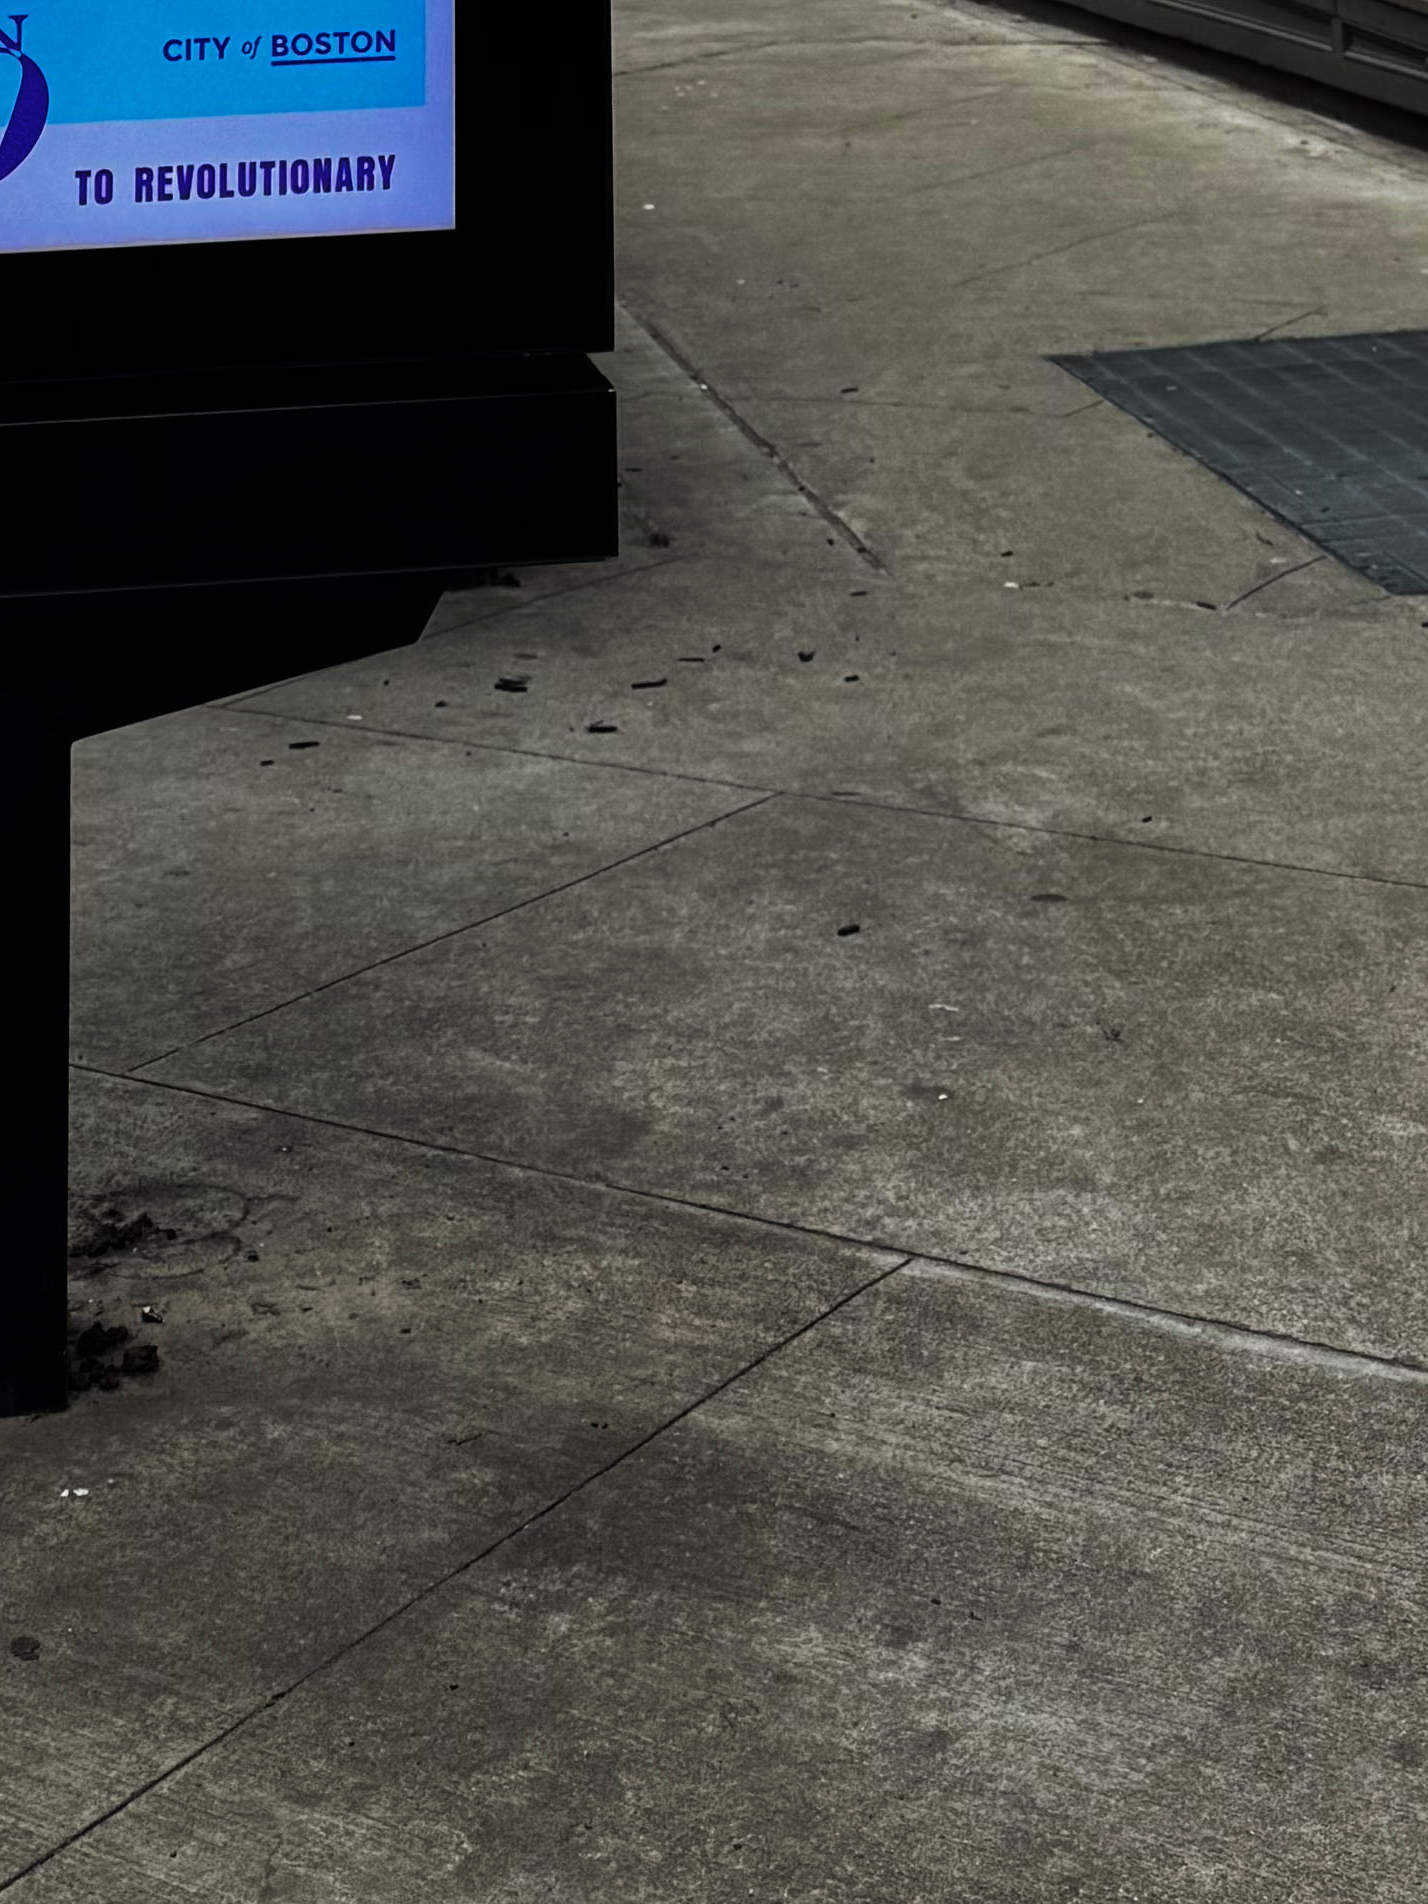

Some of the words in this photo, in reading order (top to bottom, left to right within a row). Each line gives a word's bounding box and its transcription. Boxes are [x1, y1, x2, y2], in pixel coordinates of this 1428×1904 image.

[162, 36, 231, 62] CITY
[241, 35, 262, 60] of
[271, 29, 397, 58] BOSTON
[74, 168, 114, 206] TO
[134, 154, 396, 203] REVOLUTIONARY
